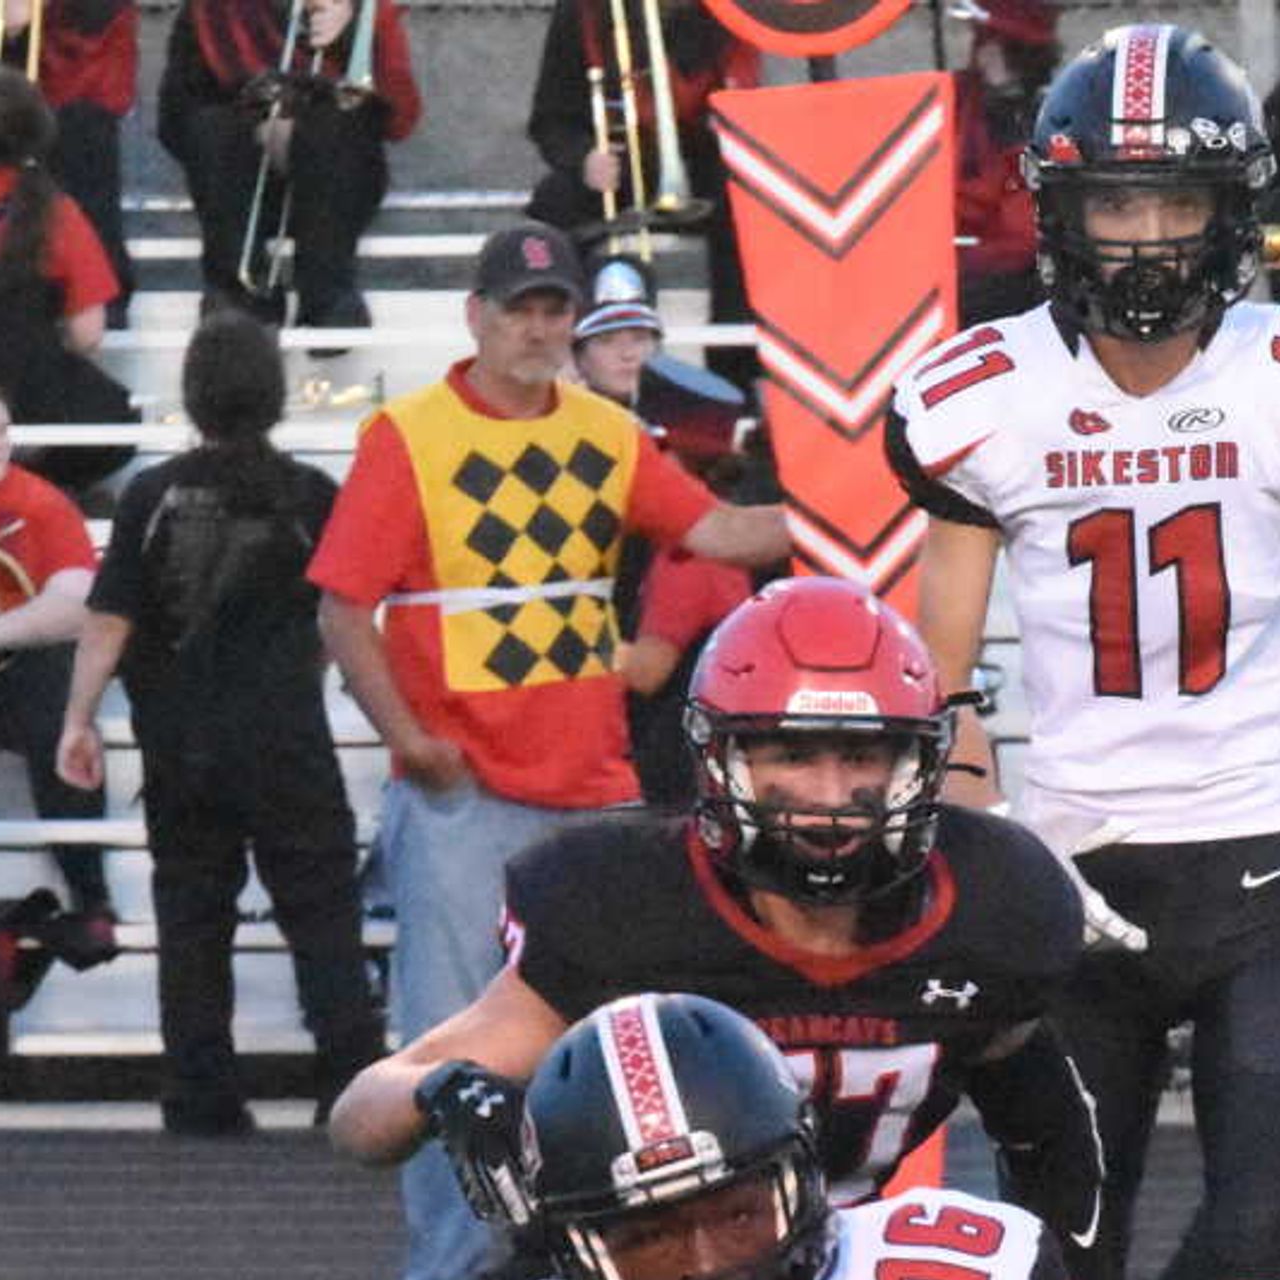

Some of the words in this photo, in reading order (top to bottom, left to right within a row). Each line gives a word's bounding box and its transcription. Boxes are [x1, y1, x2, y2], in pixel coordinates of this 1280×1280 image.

[913, 326, 1017, 412] 11
[1044, 441, 1240, 489] SIKESTON
[1066, 501, 1231, 699] 11
[782, 1044, 940, 1208] 7
